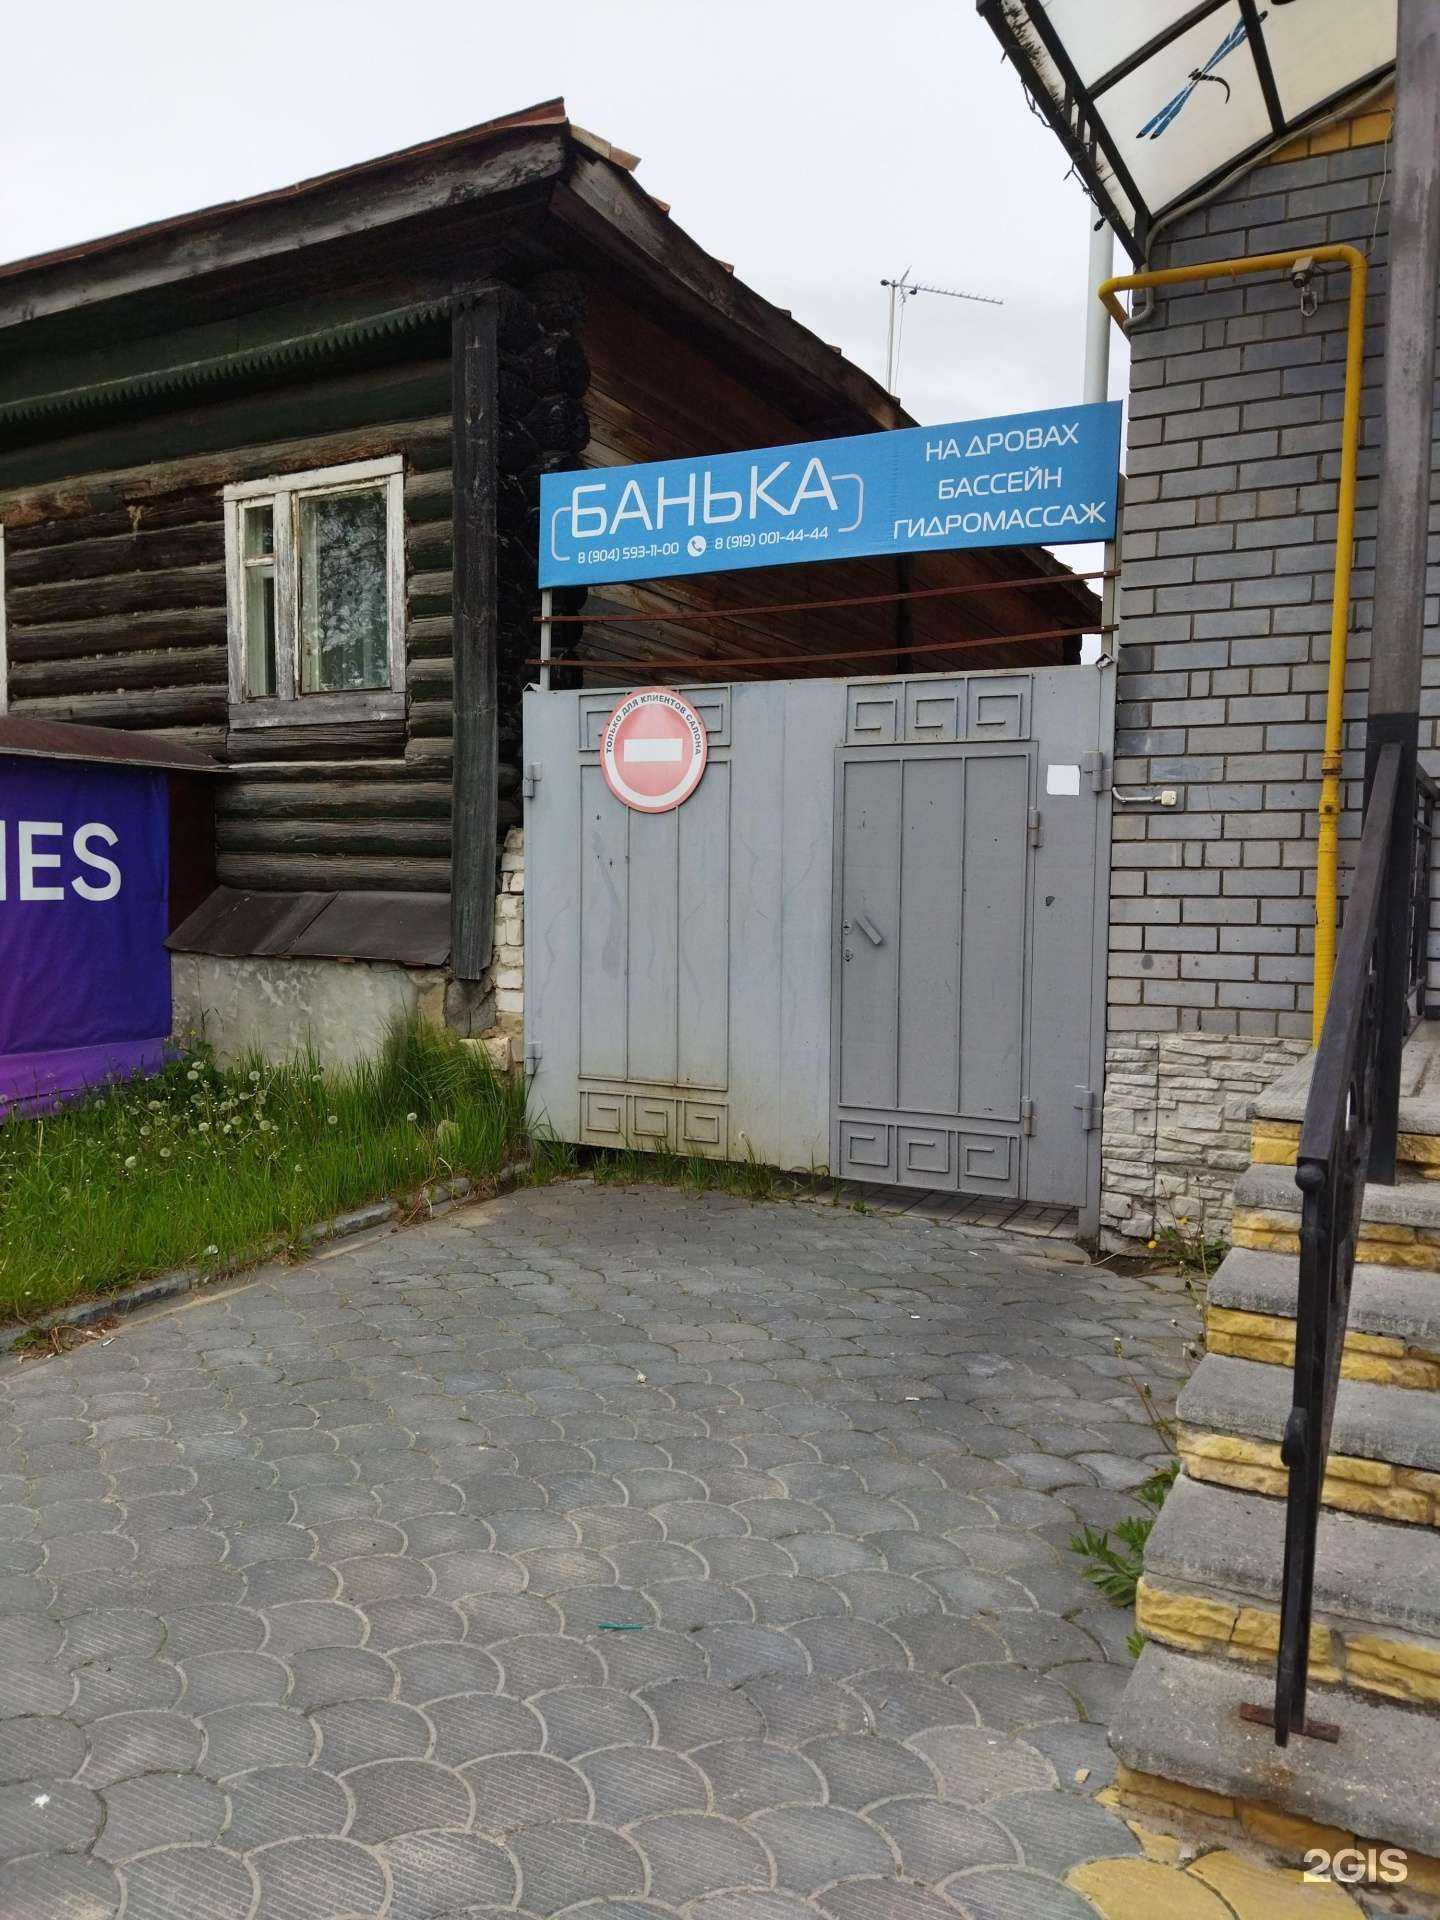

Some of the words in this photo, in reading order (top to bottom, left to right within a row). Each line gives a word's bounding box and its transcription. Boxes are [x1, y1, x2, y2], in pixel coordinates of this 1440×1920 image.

[925, 439, 960, 462] НА
[965, 422, 1079, 457] ДРОВАХ
[571, 457, 839, 538] БАНЬКА
[938, 465, 1062, 500] БАССЕЙН
[714, 537, 724, 550] 8
[726, 533, 755, 549] (919)
[759, 526, 829, 545] 001-44-44
[893, 501, 1106, 540] ГИДРОМАССАЖ
[577, 551, 585, 564] 8
[588, 547, 620, 564] (904)
[622, 542, 680, 560] 593-11-00
[606, 714, 622, 754] ТОЛЬКО
[622, 698, 639, 716] ДЛЯ
[640, 694, 687, 714] КЛИЕНТОВ
[686, 714, 702, 755] САЛОНА
